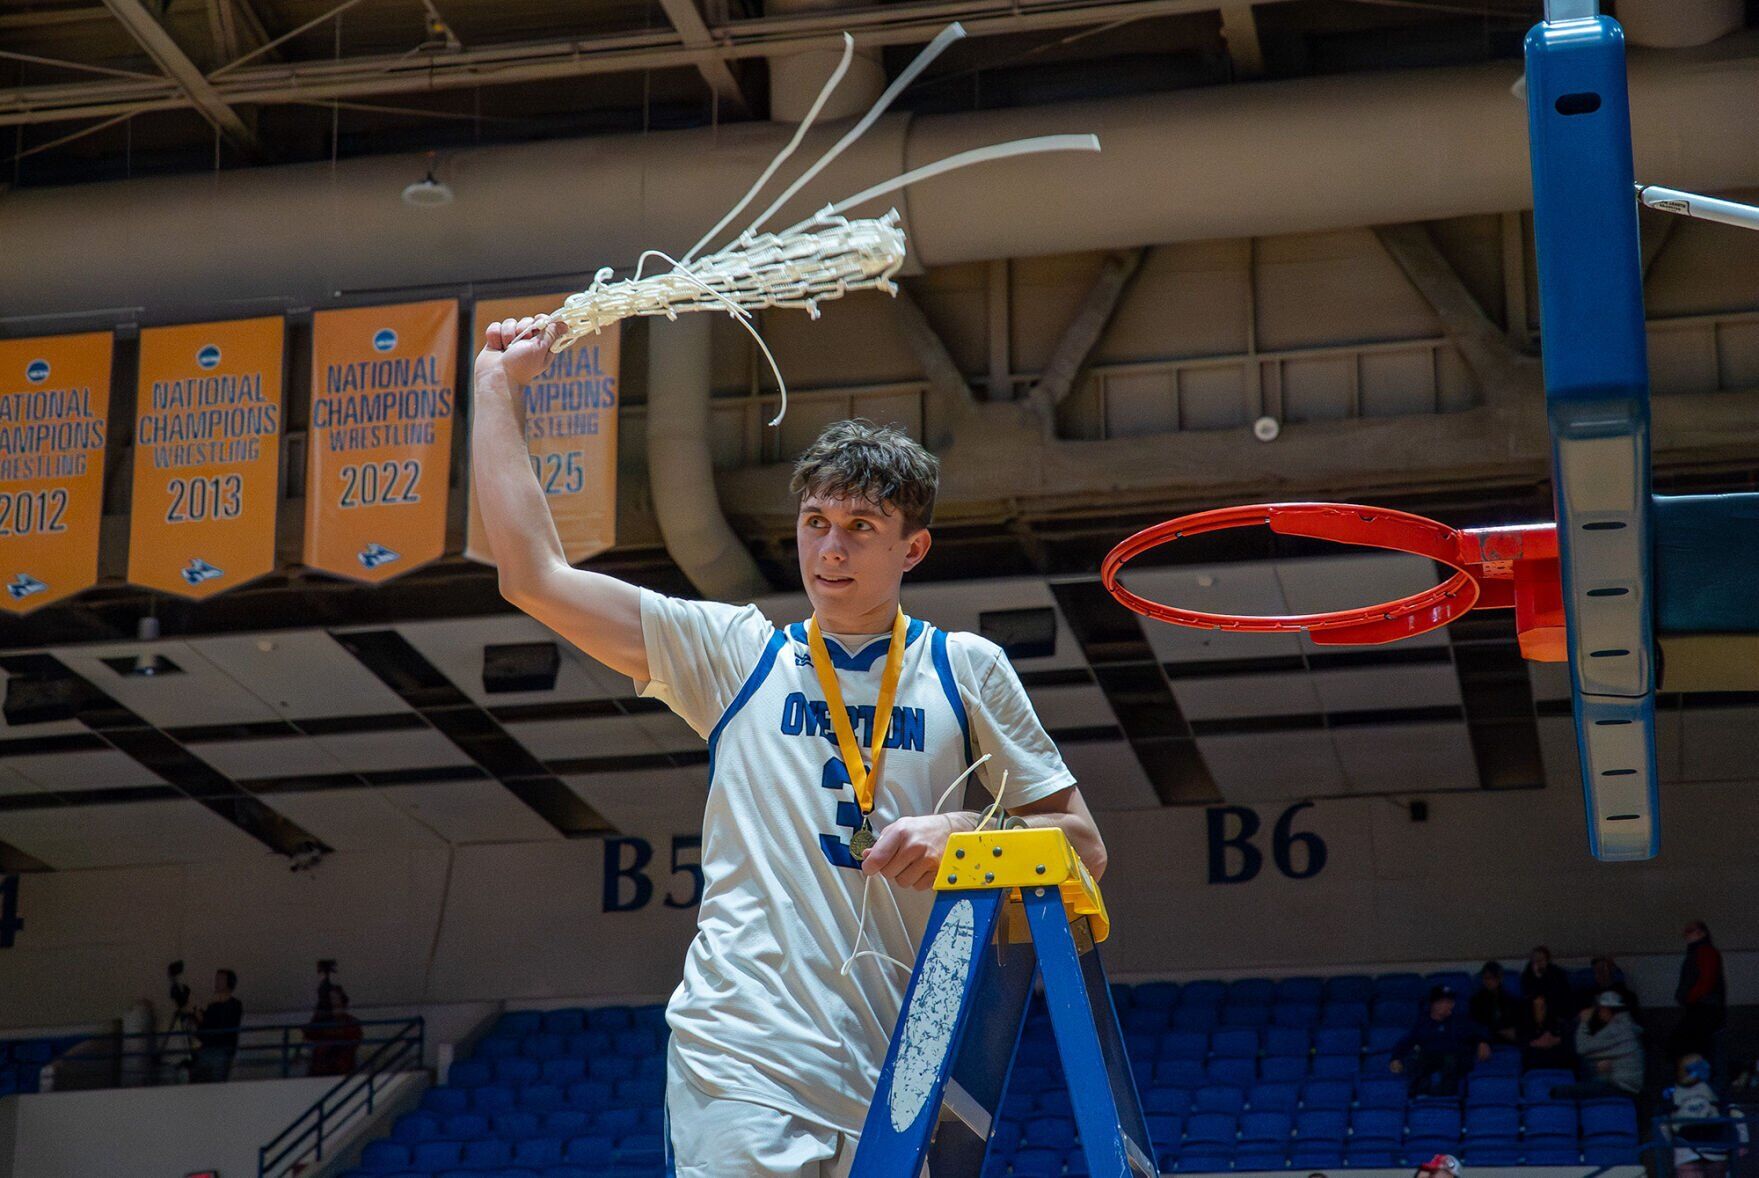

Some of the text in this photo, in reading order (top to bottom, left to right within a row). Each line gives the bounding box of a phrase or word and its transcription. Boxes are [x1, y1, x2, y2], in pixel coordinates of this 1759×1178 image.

[152, 373, 267, 410] NATIONAL
[326, 355, 441, 394] NATIONAL
[0, 388, 94, 422] ATIONAL
[313, 388, 453, 430] CHAMPIONS
[523, 376, 616, 415] MPIONS
[0, 419, 106, 456] AMPIONS
[138, 404, 279, 446] CHAMPIONS
[329, 422, 436, 453] WRESTLING
[0, 453, 87, 482] RESTLING
[154, 437, 261, 470] WRESTLING
[166, 474, 244, 523] 2013
[340, 460, 422, 508] 2022
[0, 489, 68, 537] 2012
[818, 756, 874, 870] 3
[1206, 802, 1328, 885] B6
[602, 835, 706, 913] B5
